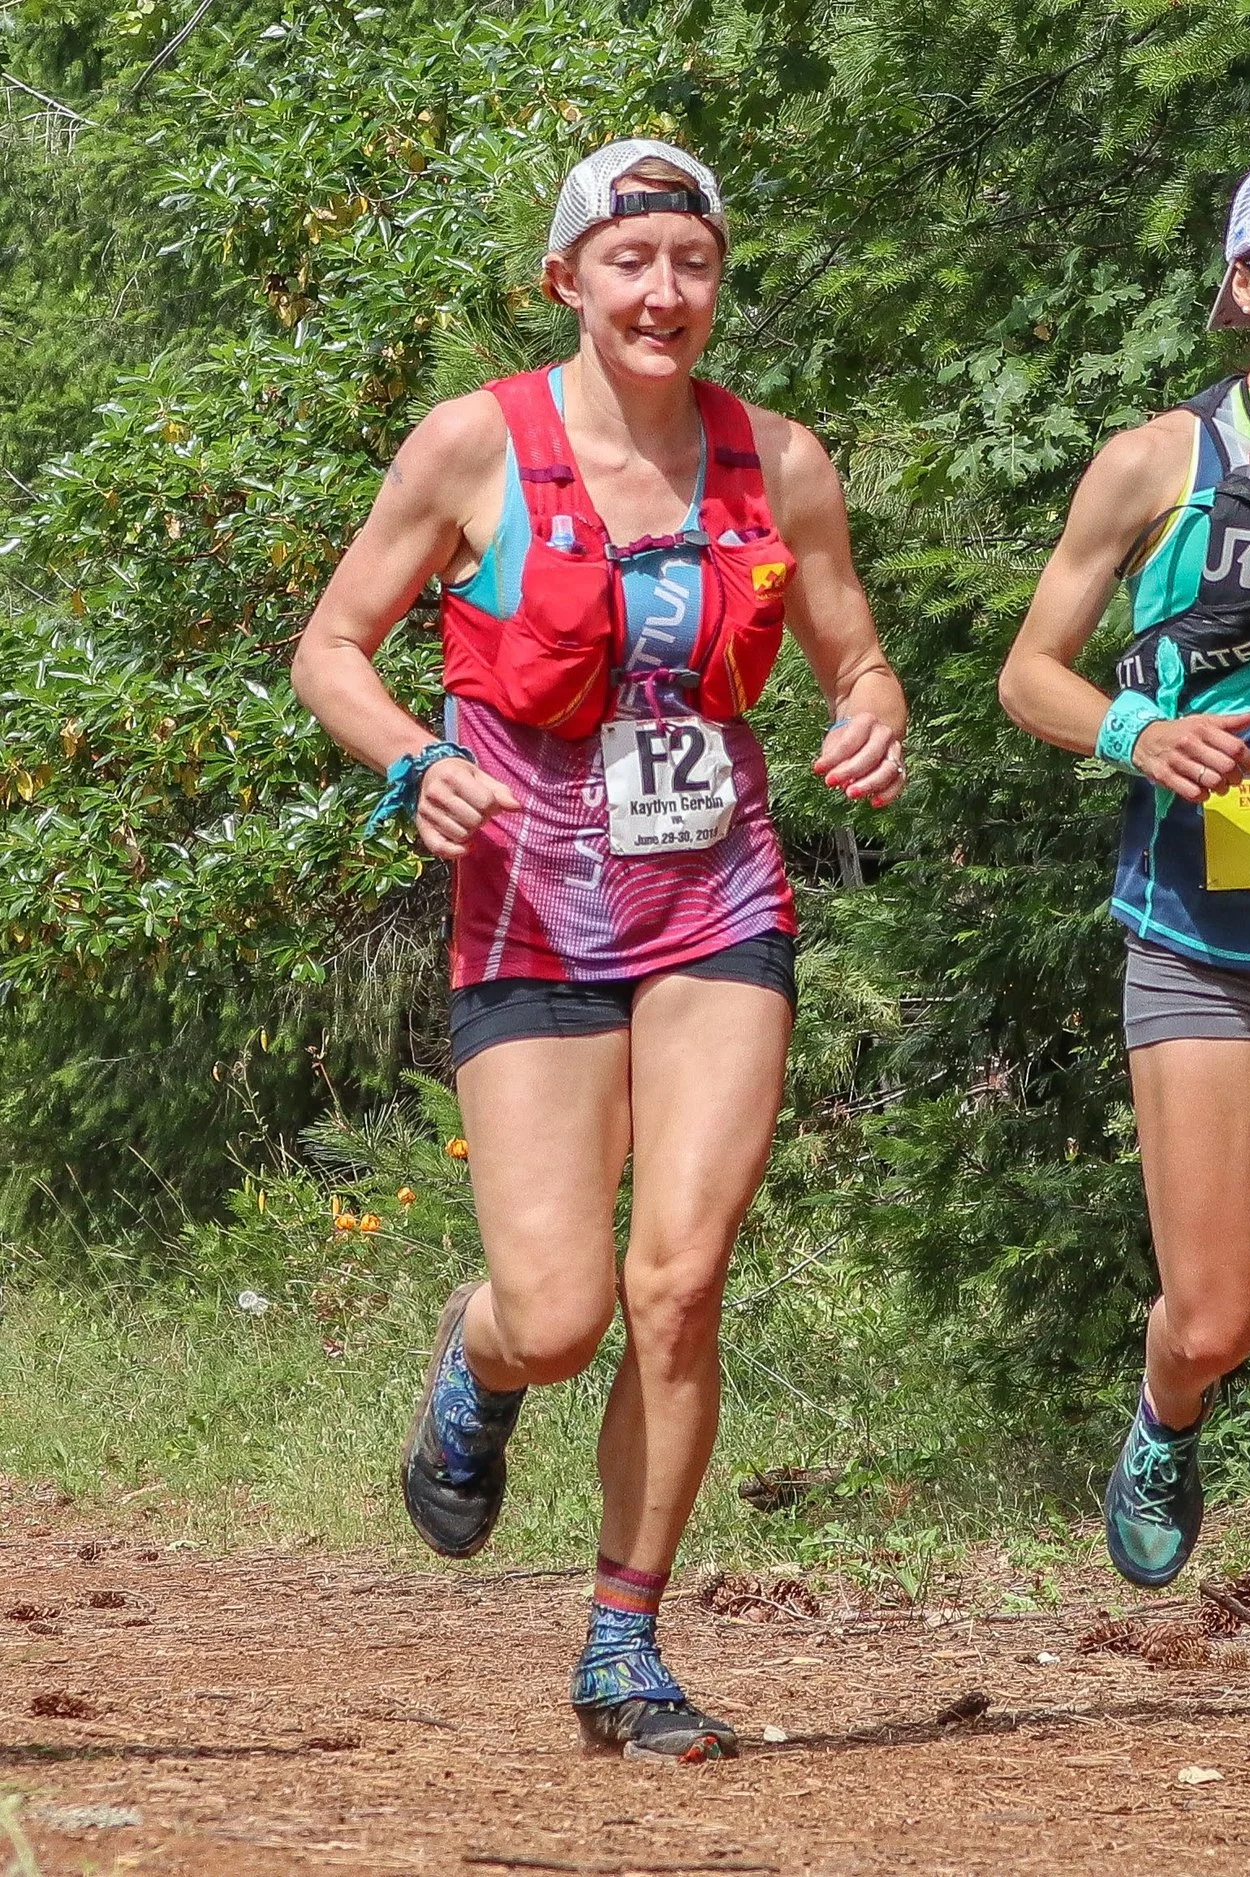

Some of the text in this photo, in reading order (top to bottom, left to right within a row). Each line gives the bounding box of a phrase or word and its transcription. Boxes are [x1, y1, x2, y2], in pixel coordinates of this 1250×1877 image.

[635, 725, 711, 796] F2
[630, 795, 724, 816] Kaytlyn Gerbin
[633, 834, 660, 846] June
